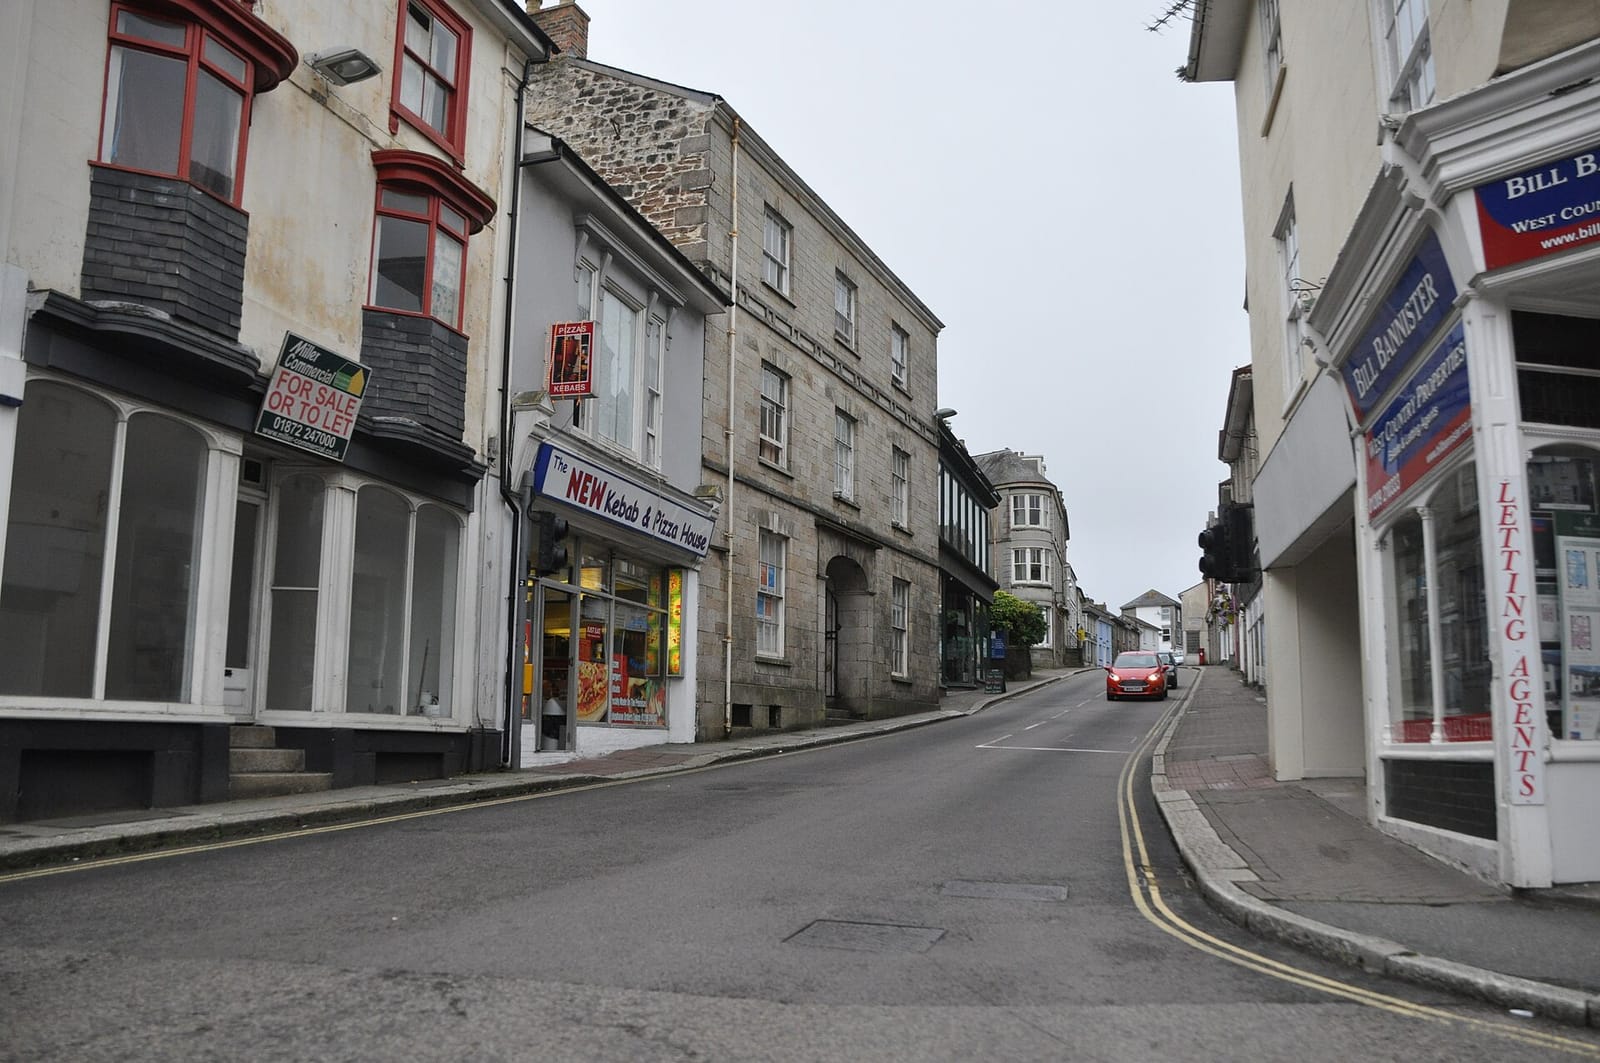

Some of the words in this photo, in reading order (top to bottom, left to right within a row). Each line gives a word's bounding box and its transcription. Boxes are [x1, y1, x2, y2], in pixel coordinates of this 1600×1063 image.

[1505, 168, 1568, 200] BILL
[1511, 214, 1556, 234] WEST
[558, 325, 587, 334] PIZZAS
[1352, 357, 1379, 399] BILL
[1372, 273, 1439, 370] BANNISTER
[284, 353, 337, 385] Commercial
[289, 341, 321, 362] Miller
[276, 370, 313, 400] FOR
[315, 386, 357, 417] SALE
[554, 383, 586, 393] KEBABS
[1416, 342, 1465, 408] PROPERTIES
[268, 391, 295, 416] OR
[299, 401, 321, 424] TO
[322, 411, 353, 436] LET
[273, 416, 303, 437] 01872
[303, 427, 336, 449] 247000
[554, 455, 568, 474] The
[566, 467, 607, 510] NEW
[604, 490, 640, 523] Kebab
[642, 507, 651, 528] &
[652, 510, 679, 540] Pizza
[681, 522, 707, 551] House
[1496, 482, 1527, 641] LETTING
[1509, 655, 1536, 798] AGENTS
